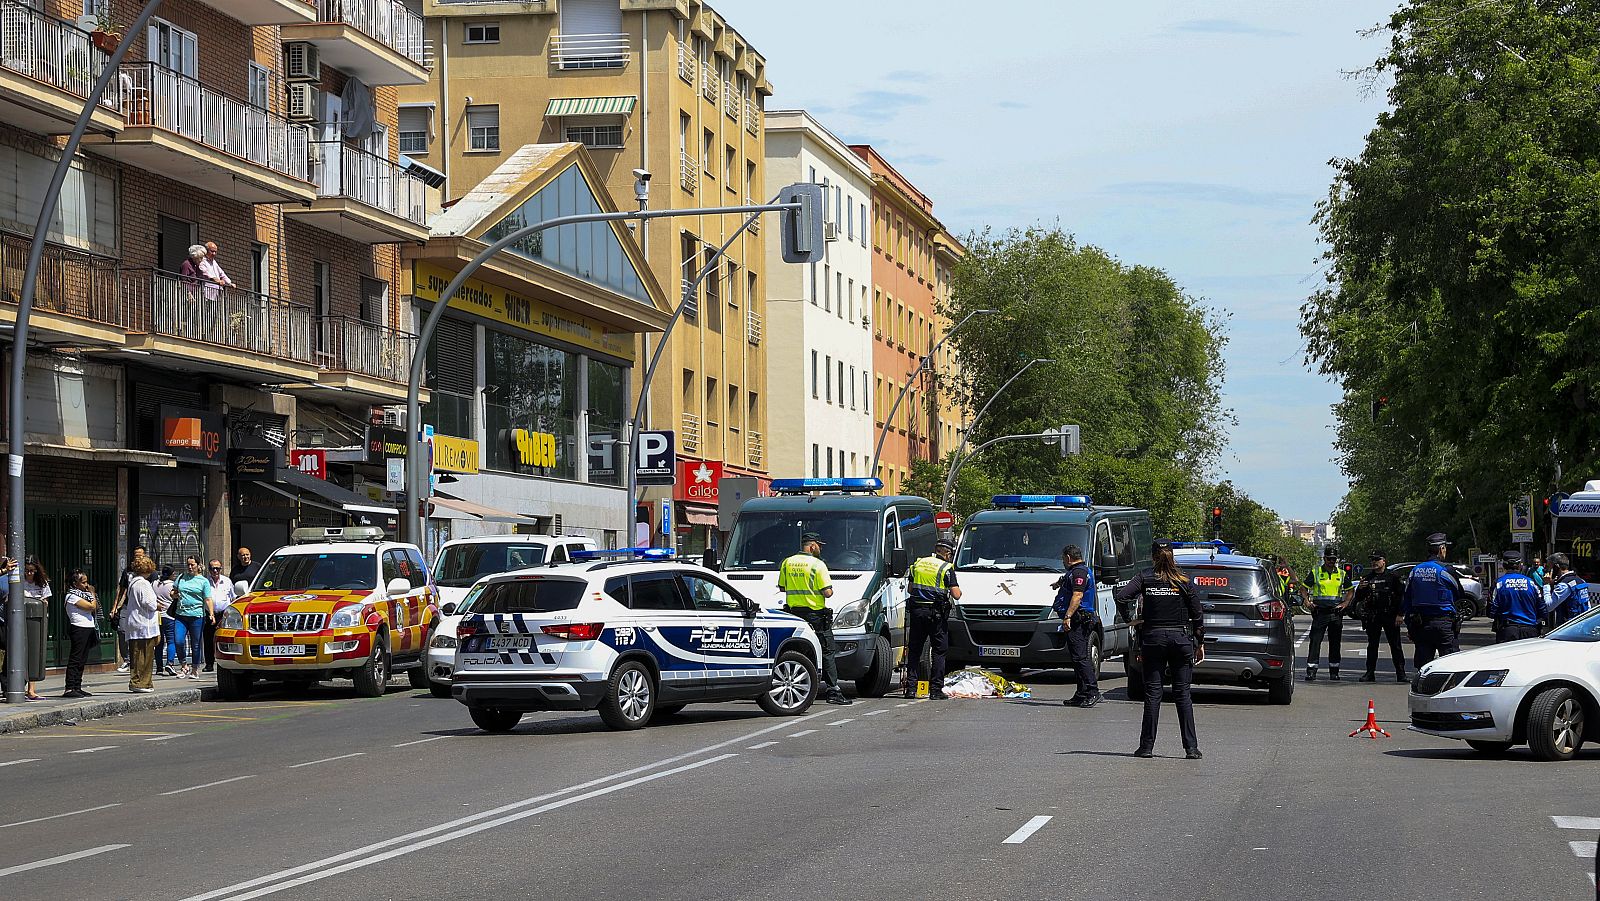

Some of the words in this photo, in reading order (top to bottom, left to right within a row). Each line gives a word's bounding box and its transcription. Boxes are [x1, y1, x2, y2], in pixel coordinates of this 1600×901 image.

[428, 274, 493, 309] supemercados
[639, 433, 668, 468] P
[1577, 542, 1592, 557] 112
[987, 609, 1016, 617] IVECO
[690, 627, 751, 643] POLICÍA
[491, 638, 510, 648] 5437
[615, 637, 629, 646] 112
[265, 646, 286, 654] 4112
[287, 645, 304, 655] FZL
[920, 683, 926, 691] 3
